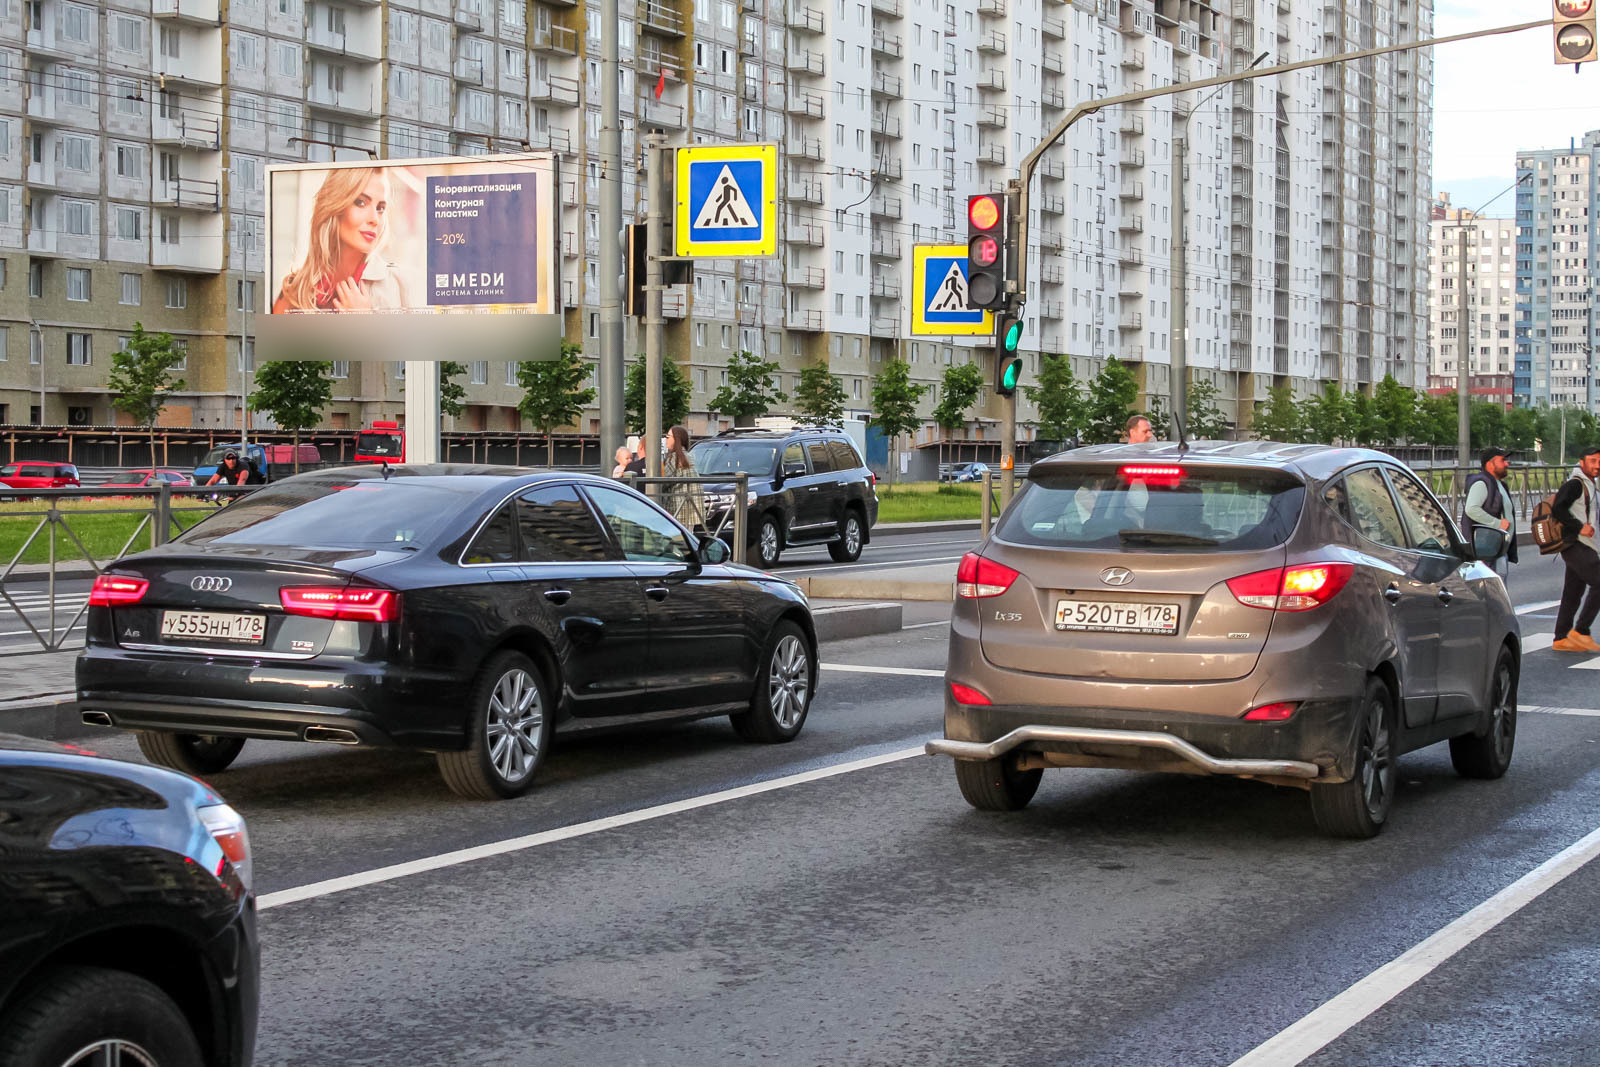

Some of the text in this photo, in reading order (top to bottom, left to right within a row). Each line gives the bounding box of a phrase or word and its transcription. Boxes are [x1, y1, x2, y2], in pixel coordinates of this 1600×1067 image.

[434, 183, 522, 195] Биоревитализация
[434, 199, 484, 209] Контурная
[434, 209, 479, 218] пластика
[435, 288, 505, 297] СИСТЕМА КЛИНИК
[1143, 606, 1172, 621] 178
[235, 616, 261, 632] 178
